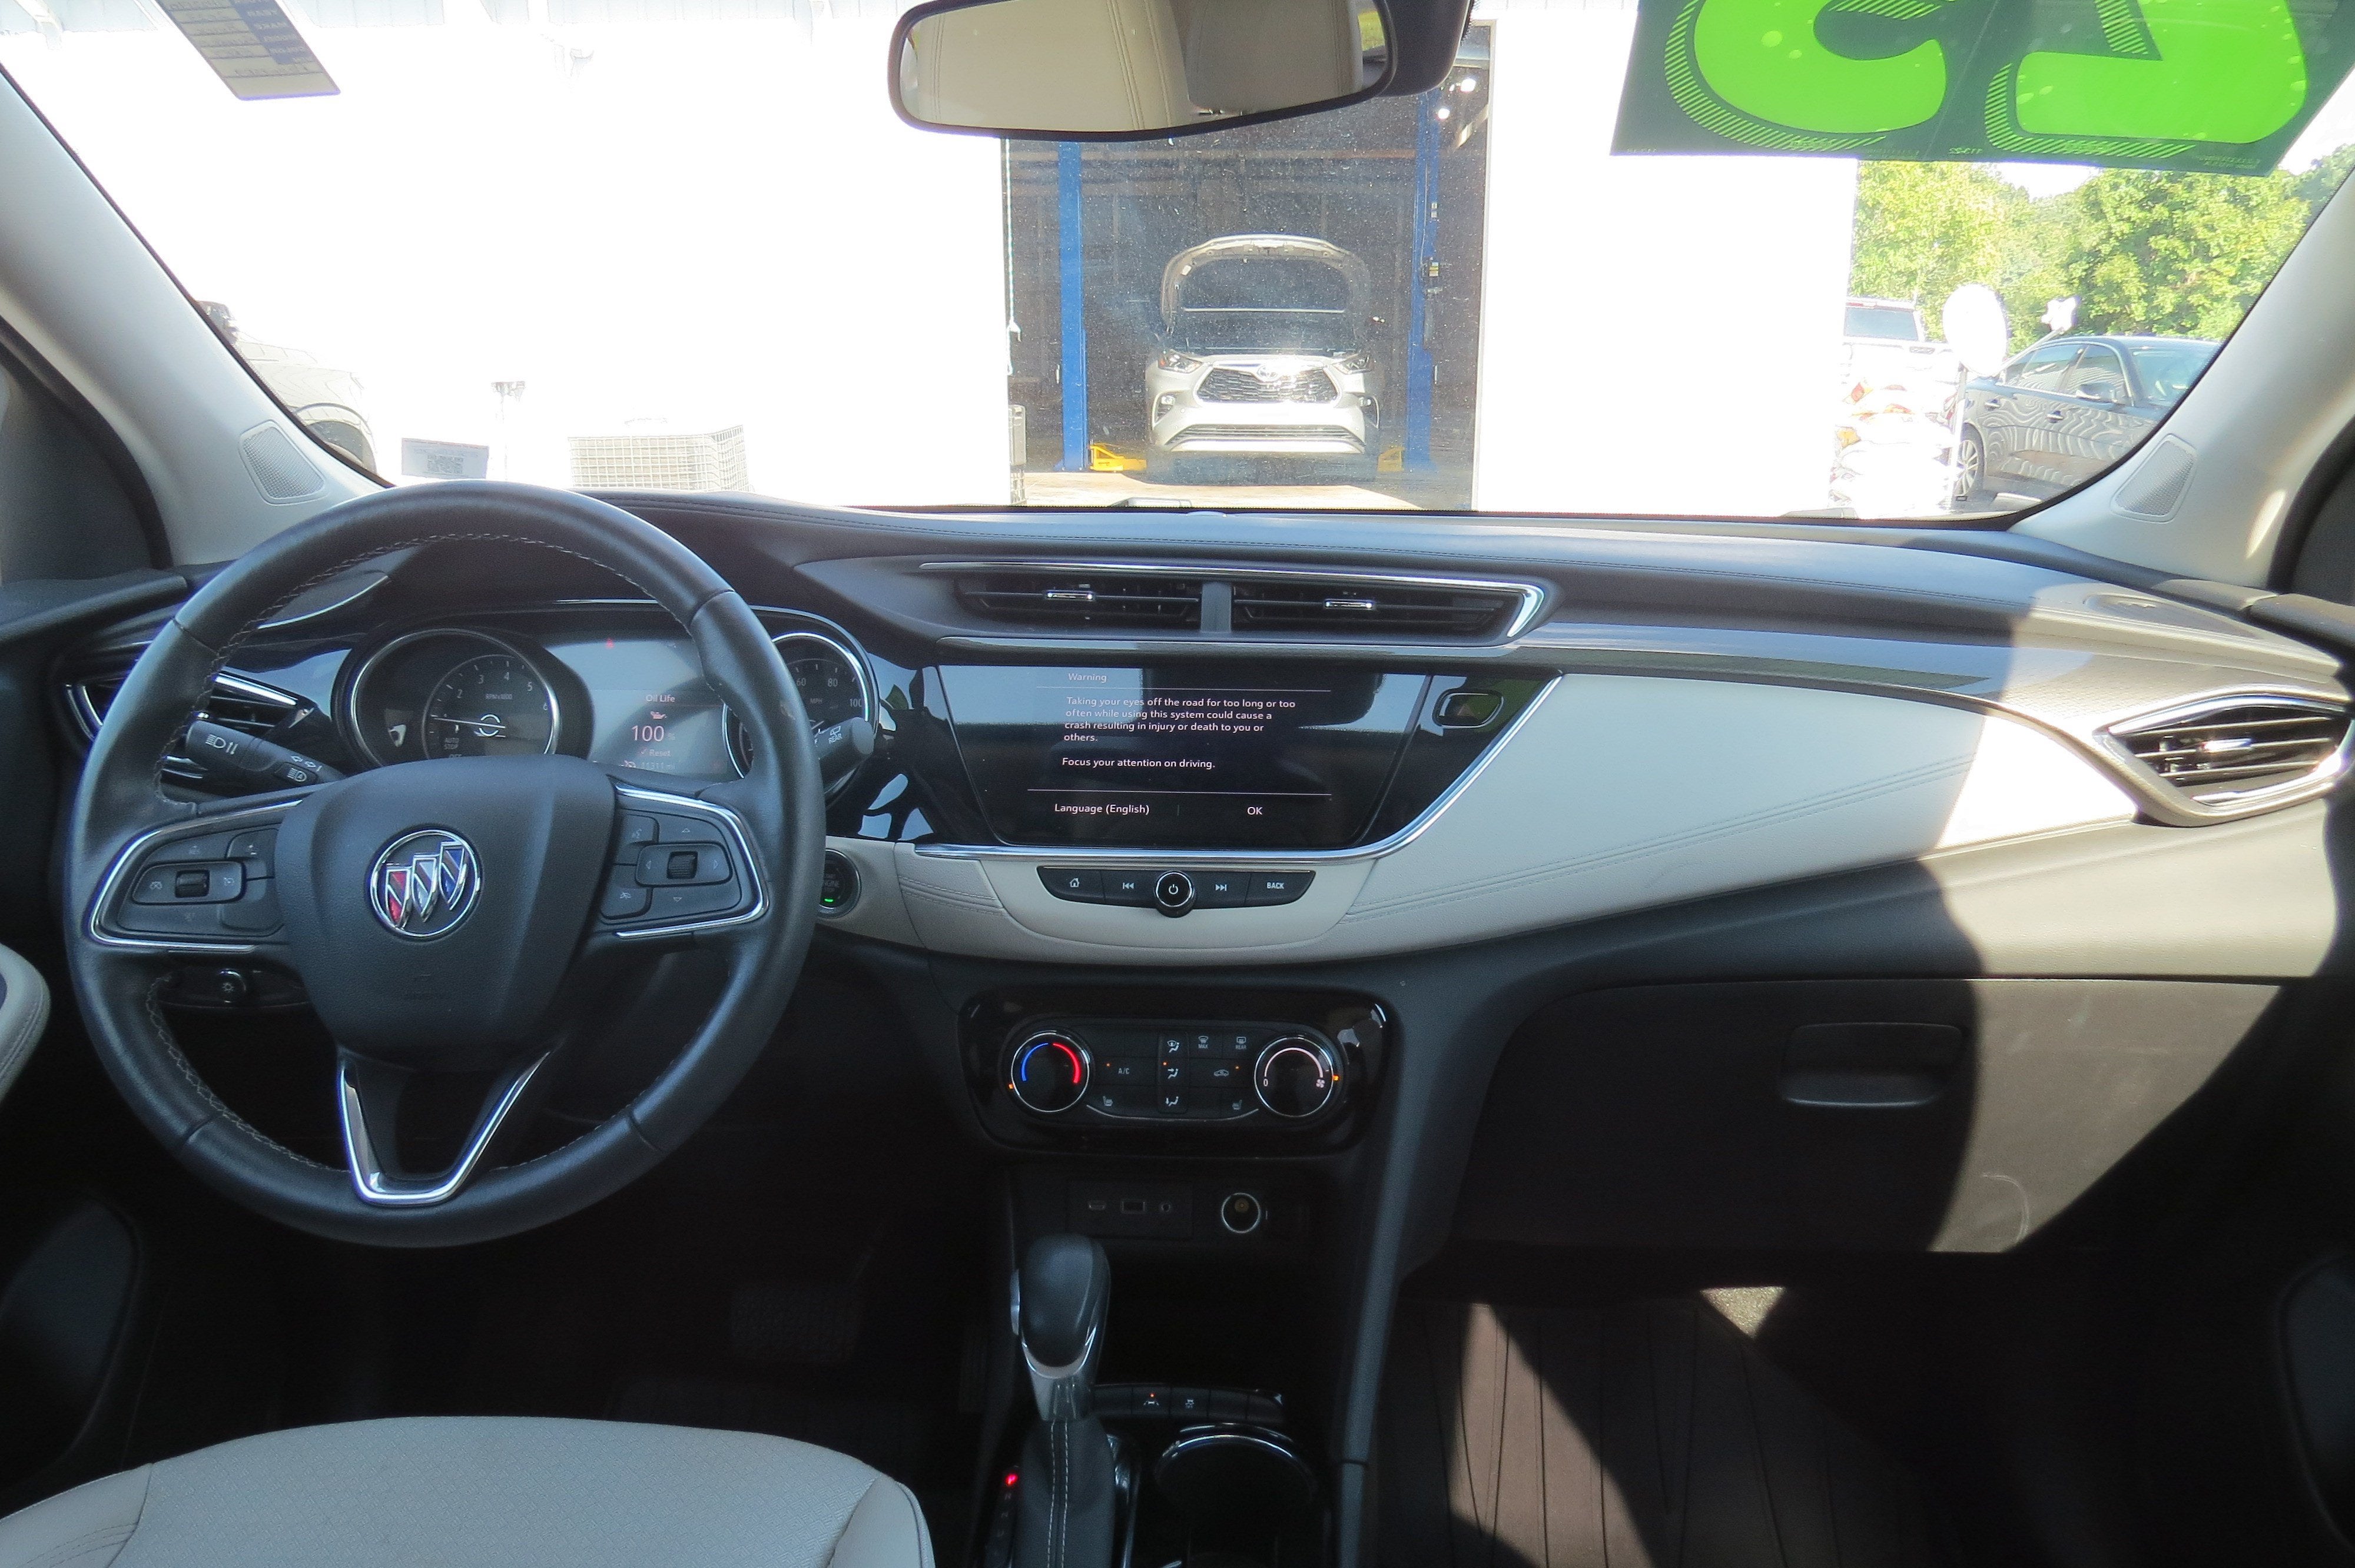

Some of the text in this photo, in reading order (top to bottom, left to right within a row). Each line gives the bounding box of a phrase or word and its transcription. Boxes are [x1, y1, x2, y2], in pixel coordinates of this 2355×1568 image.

[477, 675, 485, 684] 3
[503, 671, 510, 681] 4
[1068, 672, 1107, 683] Warning
[526, 681, 533, 692] 5
[796, 678, 807, 686] 60
[827, 678, 838, 687] 80
[457, 689, 463, 699] 2
[645, 694, 676, 703] Oil Life
[1066, 696, 1097, 707] Taking
[1099, 699, 1121, 707] your
[1123, 699, 1145, 707] eyes
[1147, 697, 1163, 706] off
[1164, 697, 1180, 706] the
[1182, 697, 1205, 707] road
[1206, 698, 1220, 707] for
[1223, 699, 1240, 707] too
[1242, 699, 1264, 710] long
[1279, 700, 1296, 709] too
[1065, 709, 1092, 718] often
[1094, 709, 1119, 718] while
[1122, 710, 1147, 720] using
[1150, 710, 1168, 719] this
[1170, 711, 1205, 722] system
[1206, 710, 1233, 720] could
[1064, 721, 1264, 734] crash resulting in injury or death to you or
[631, 725, 665, 742] 100
[1063, 733, 1099, 742] others.
[649, 748, 671, 757] Reset
[1062, 757, 1216, 770] Focus your attention on driving.
[1054, 803, 1150, 815] Language (English)
[1247, 806, 1263, 816] OK
[1266, 882, 1285, 890] BACK
